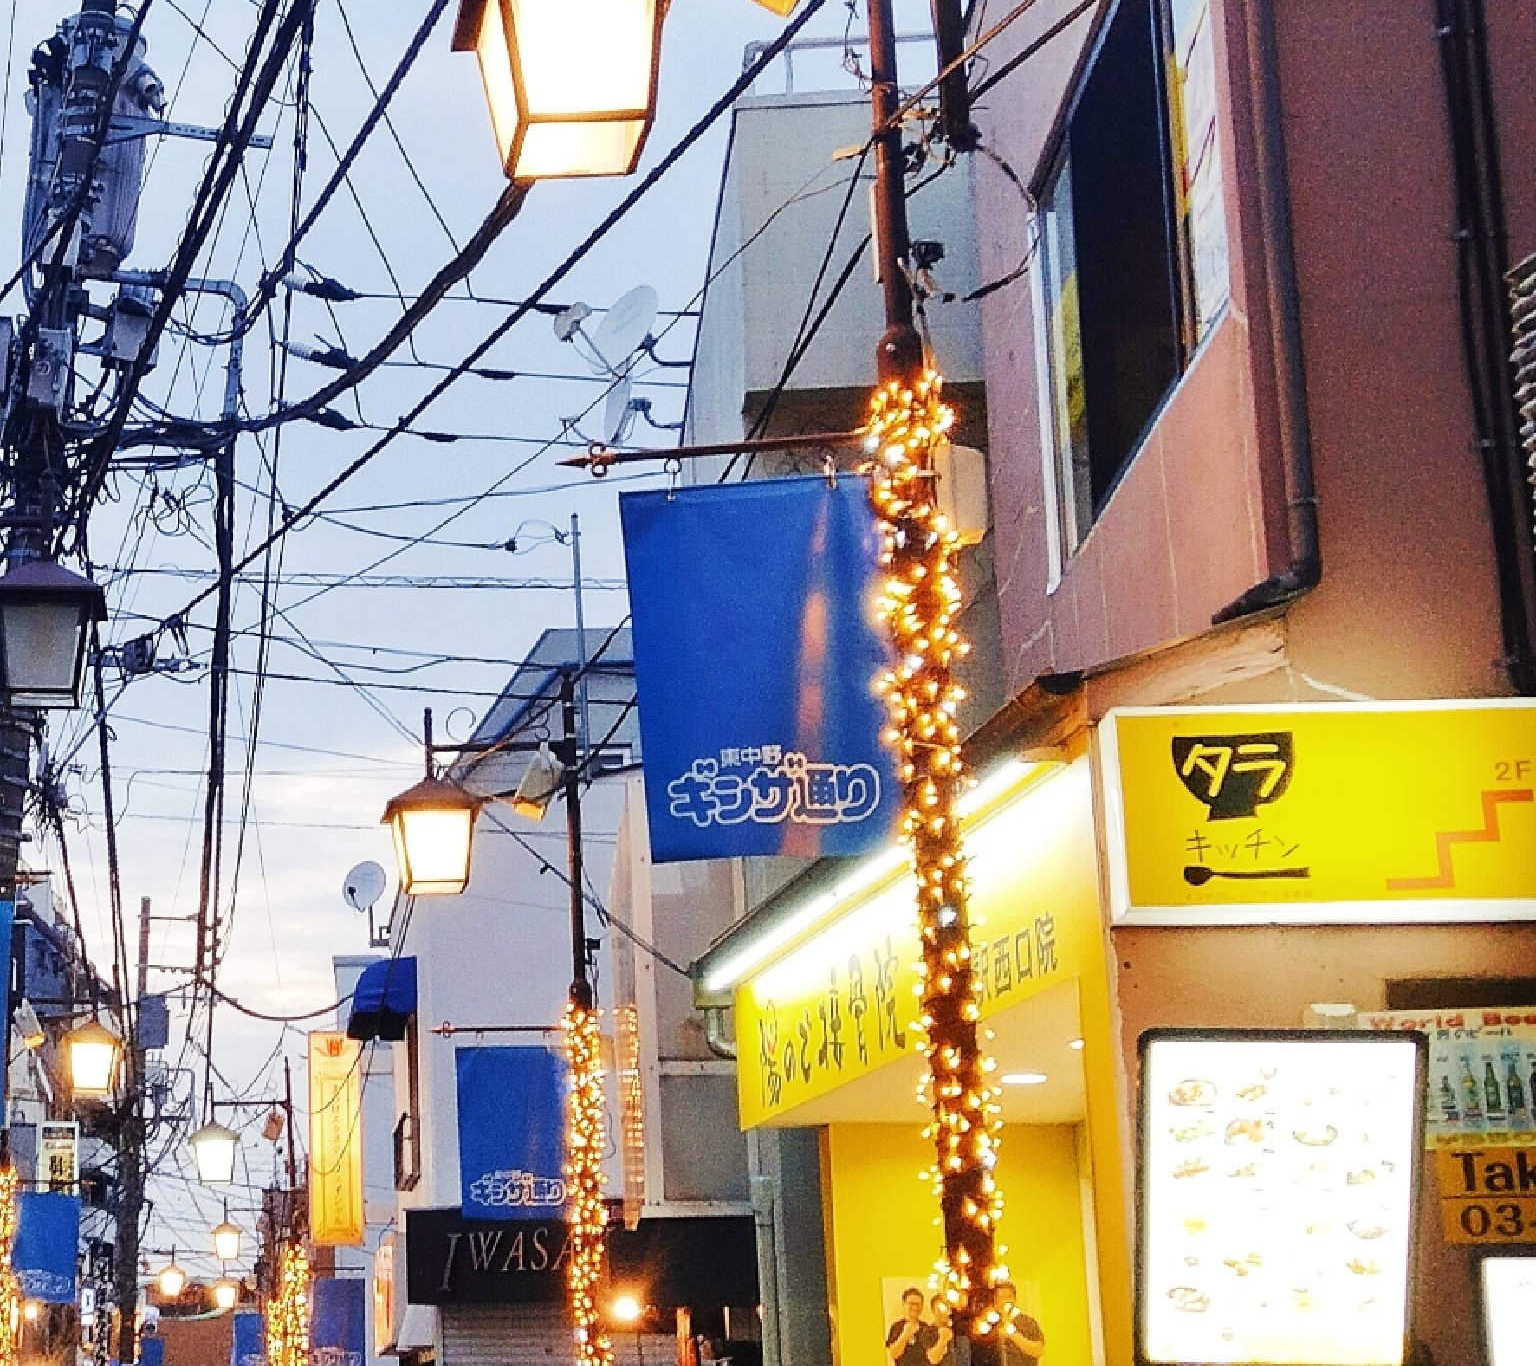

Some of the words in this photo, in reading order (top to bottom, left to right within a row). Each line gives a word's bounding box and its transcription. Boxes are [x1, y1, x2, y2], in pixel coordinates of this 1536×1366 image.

[1182, 743, 1287, 798] タラ
[1494, 760, 1532, 781] 2F
[667, 751, 882, 828] ギンザ通り
[1185, 828, 1300, 864] キッチン
[1369, 1013, 1464, 1030] World
